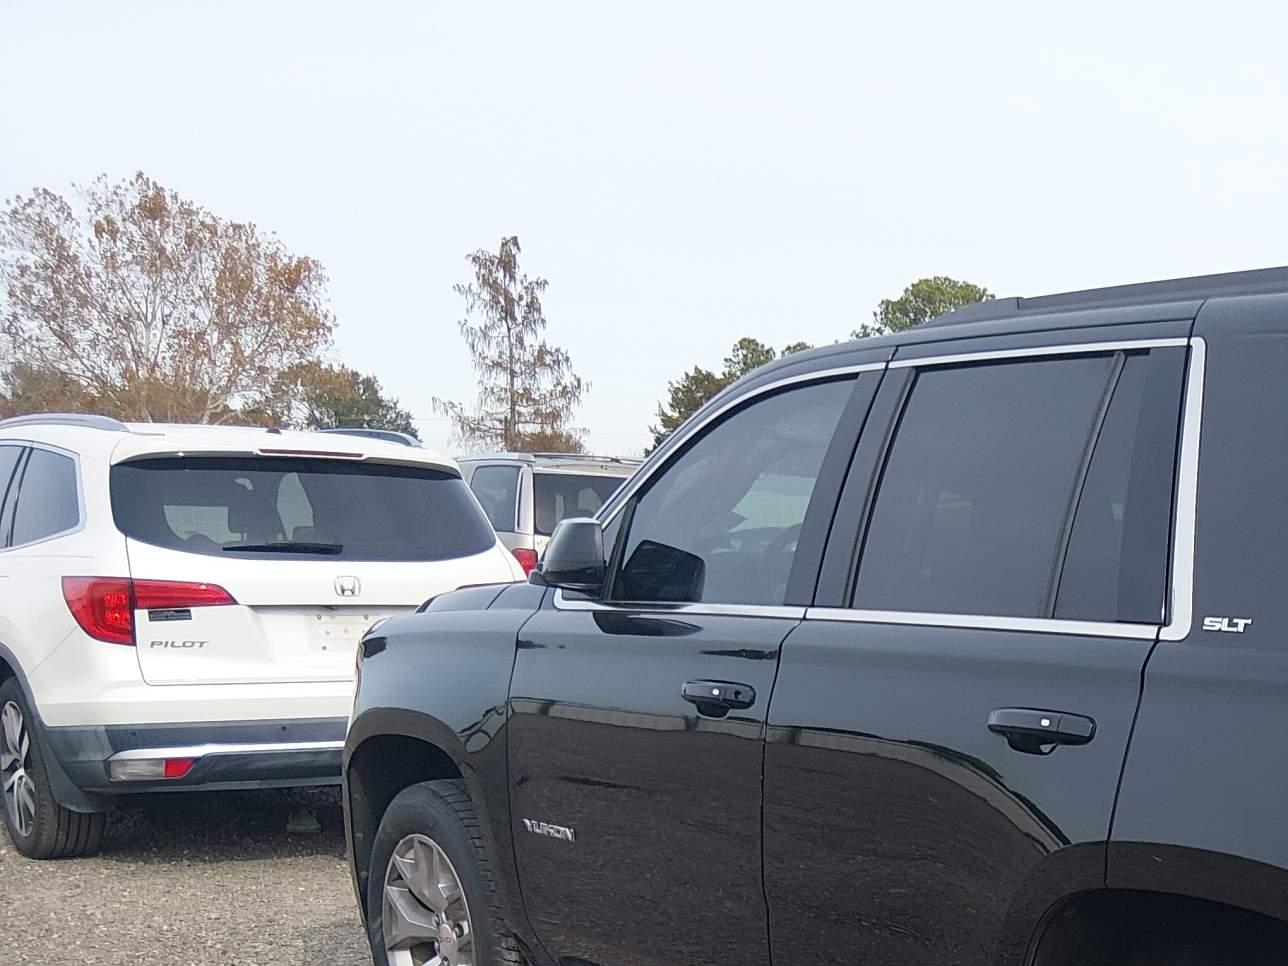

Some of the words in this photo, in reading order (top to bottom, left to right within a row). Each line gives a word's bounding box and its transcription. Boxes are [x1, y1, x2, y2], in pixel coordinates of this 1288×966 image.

[1202, 616, 1252, 633] SLT
[149, 640, 209, 649] PILOT
[522, 818, 576, 843] YUKON
